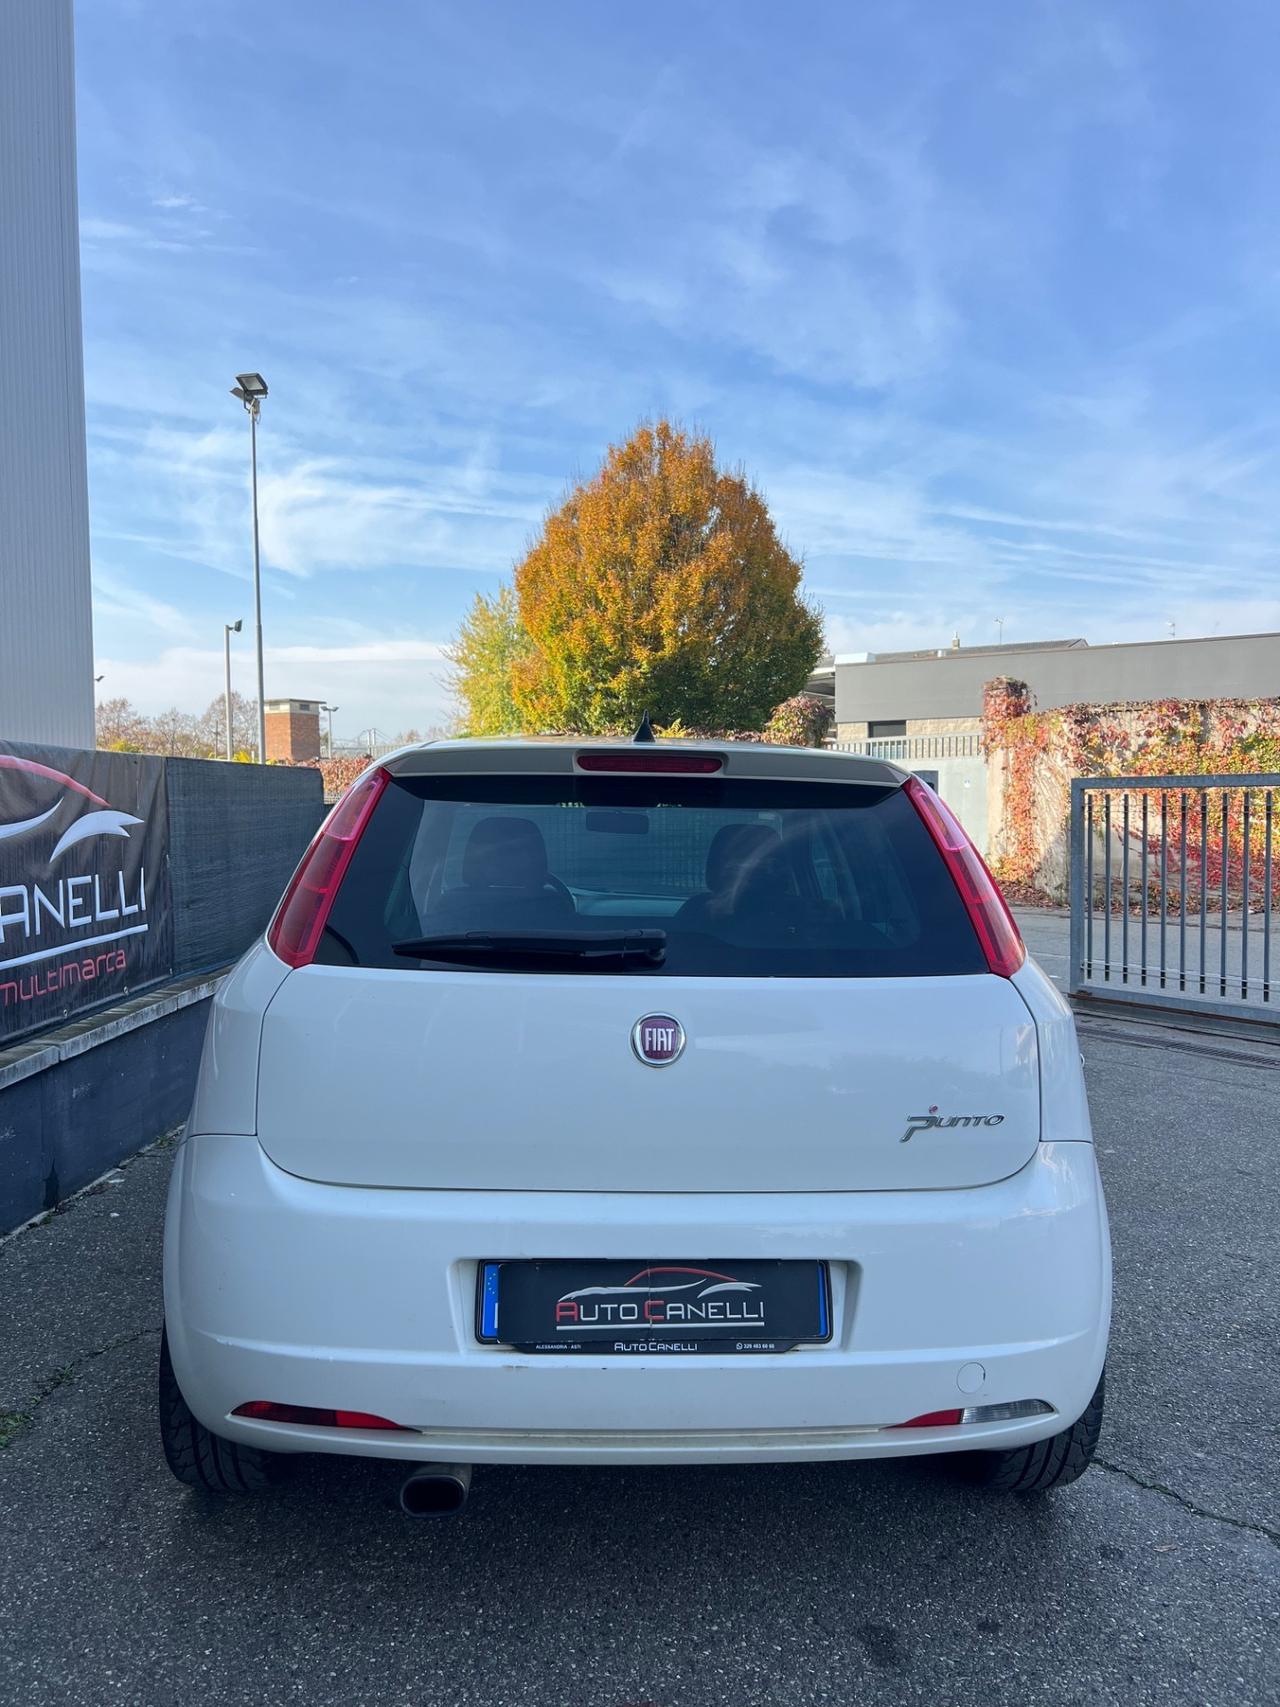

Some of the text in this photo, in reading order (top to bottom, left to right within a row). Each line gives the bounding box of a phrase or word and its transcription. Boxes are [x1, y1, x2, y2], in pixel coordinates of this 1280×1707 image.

[644, 1027, 675, 1051] FIAT
[555, 1300, 765, 1322] AUTO CANELLI
